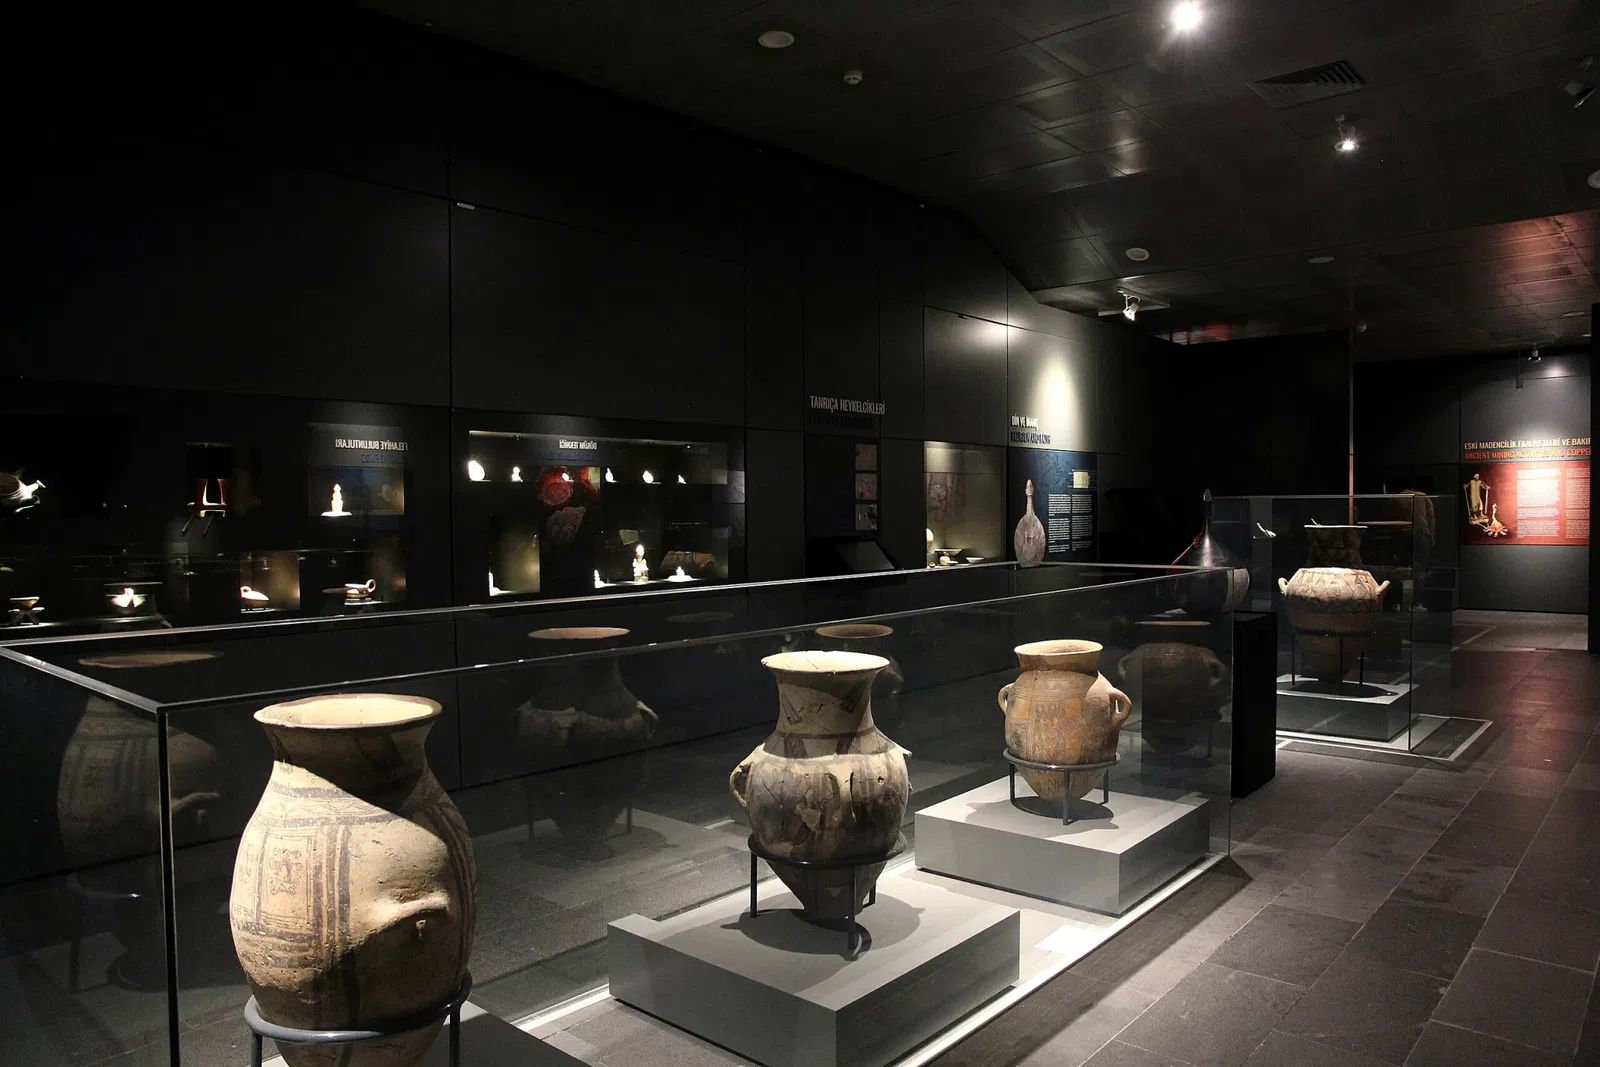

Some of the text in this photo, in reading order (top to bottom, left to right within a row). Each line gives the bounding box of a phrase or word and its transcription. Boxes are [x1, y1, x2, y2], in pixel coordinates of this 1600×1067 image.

[809, 395, 886, 415] TANRIÇA HEYKELCİKLERİ
[1464, 441, 1478, 450] ESKİ
[1479, 439, 1516, 449] MADENCİLİK
[1561, 438, 1570, 446] VE
